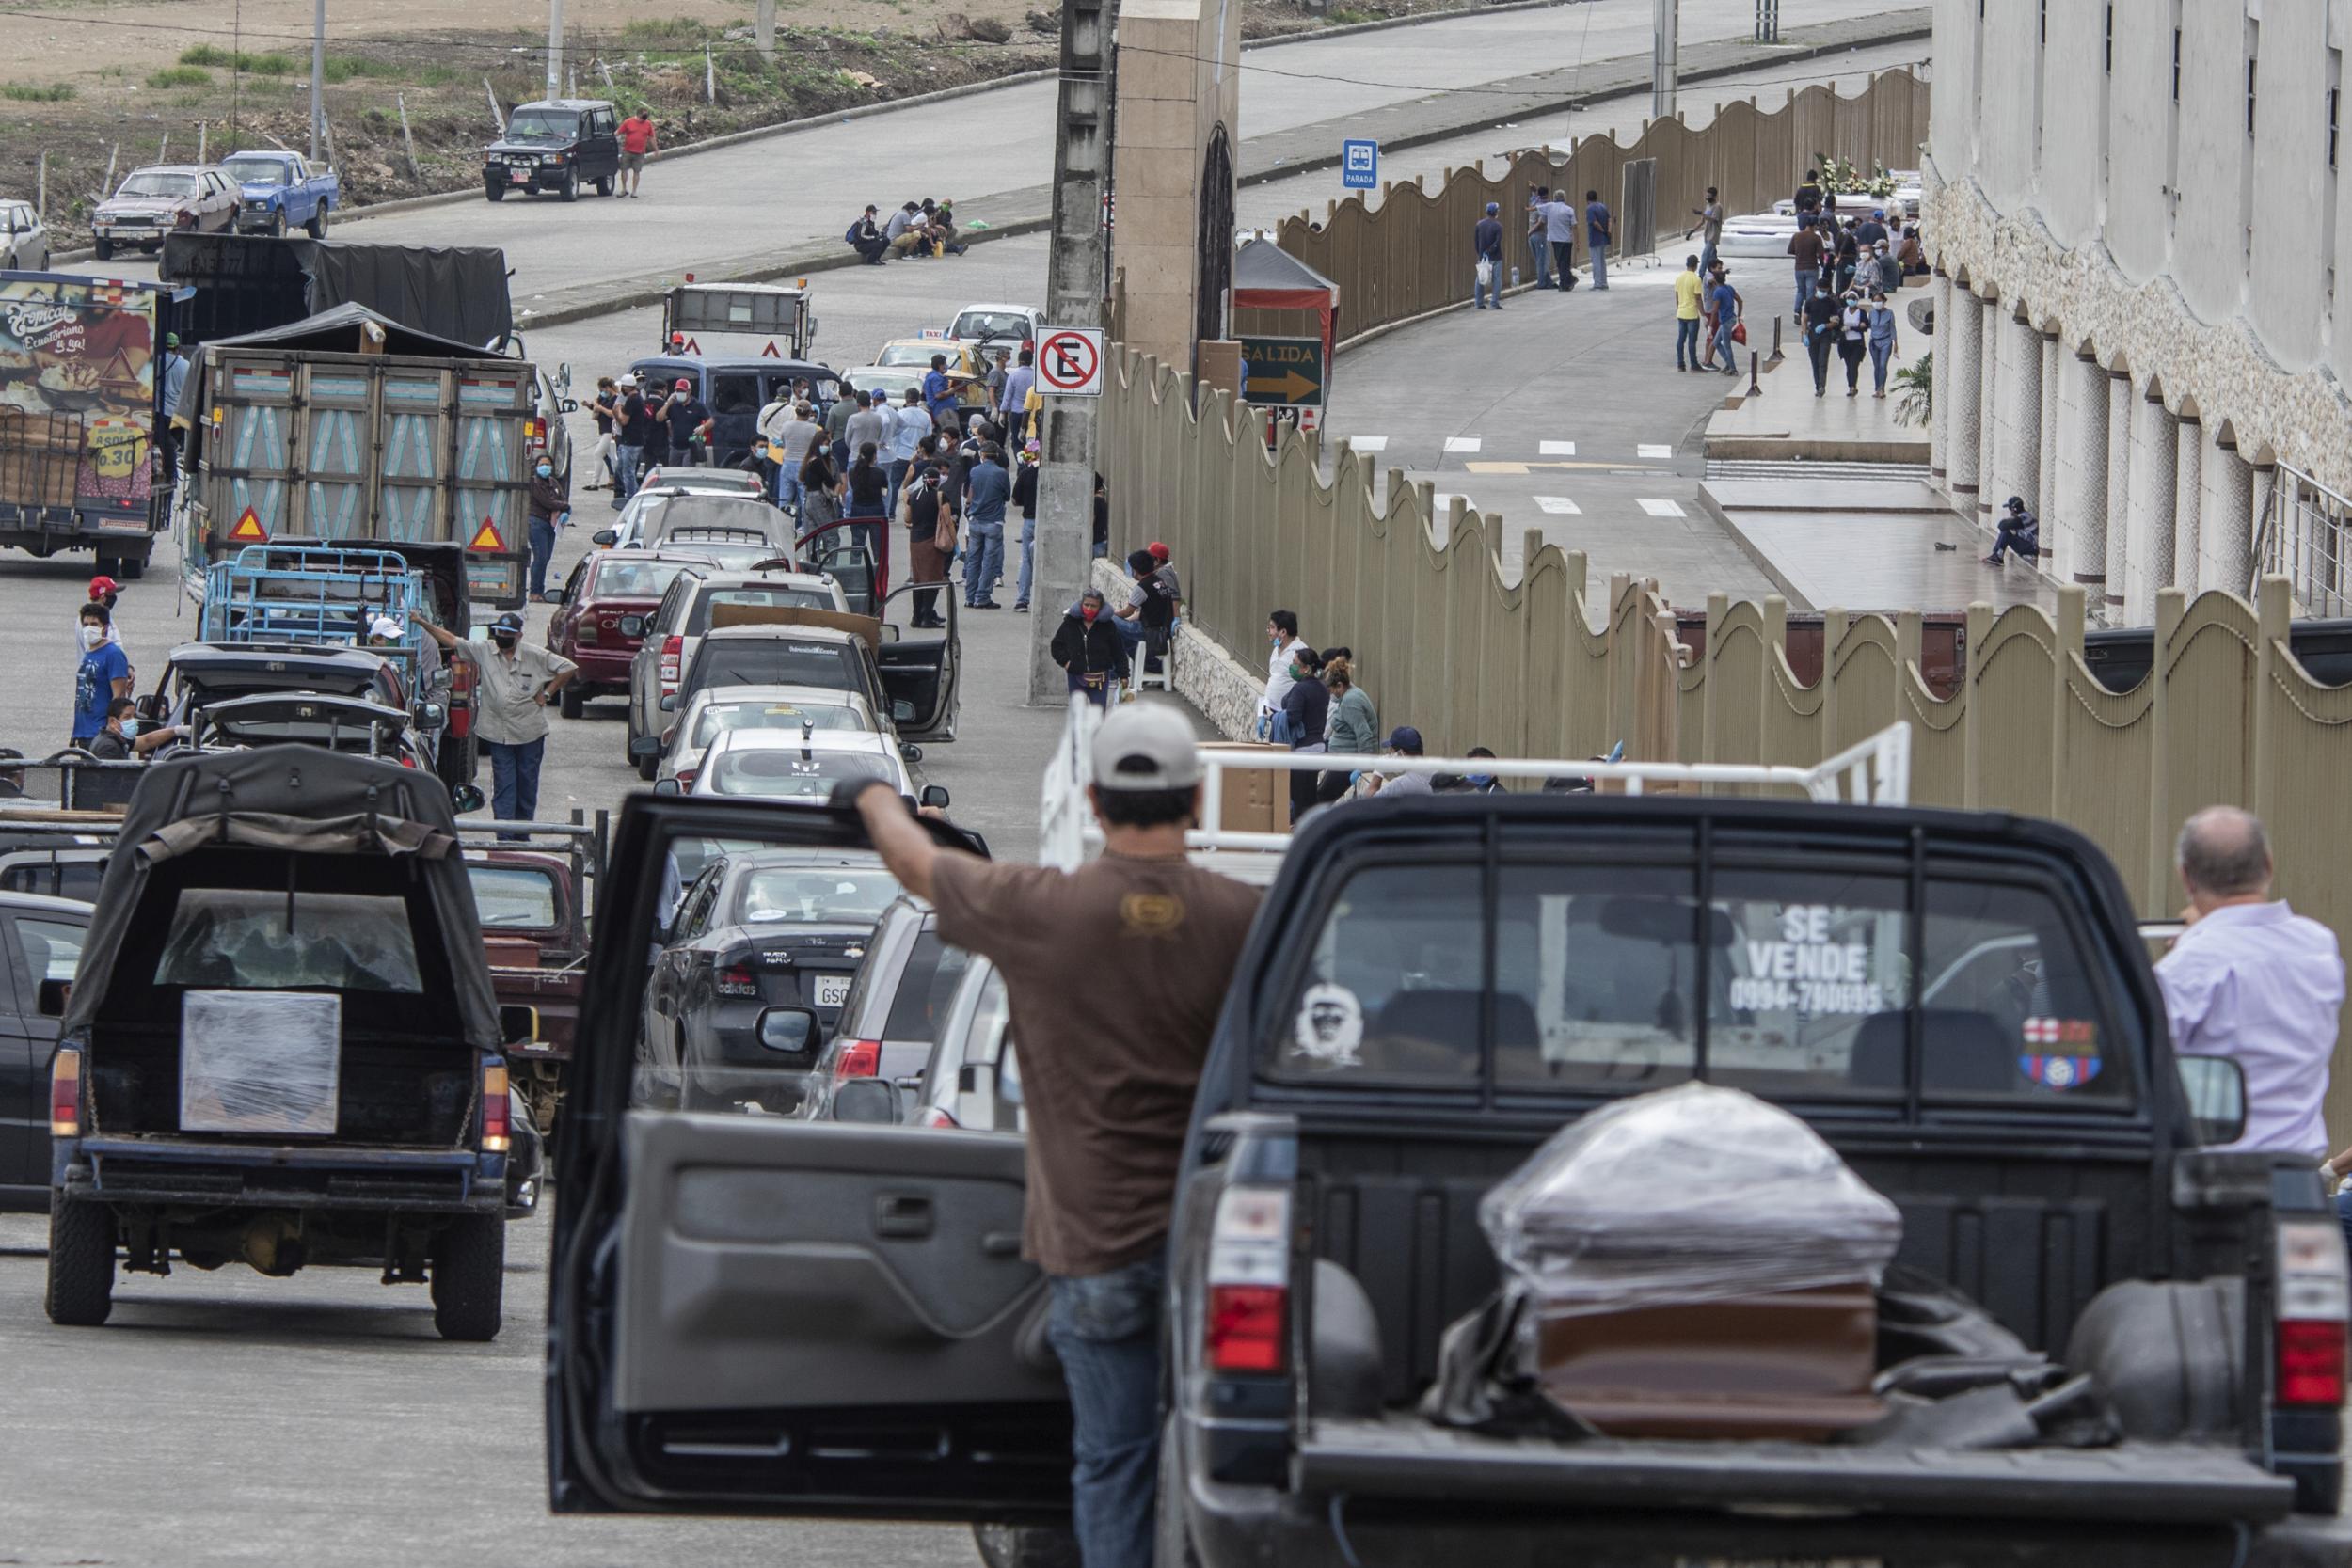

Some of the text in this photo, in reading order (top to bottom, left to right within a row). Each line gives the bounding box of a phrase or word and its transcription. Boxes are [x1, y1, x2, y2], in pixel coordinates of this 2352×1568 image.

[1346, 175, 1374, 183] PARADA
[6, 297, 77, 337] Tropical
[1057, 343, 1081, 377] E
[1241, 345, 1315, 363] SALIDA
[1785, 904, 1830, 942] SE
[1747, 942, 1867, 981] VENDE
[718, 983, 756, 995] adidas
